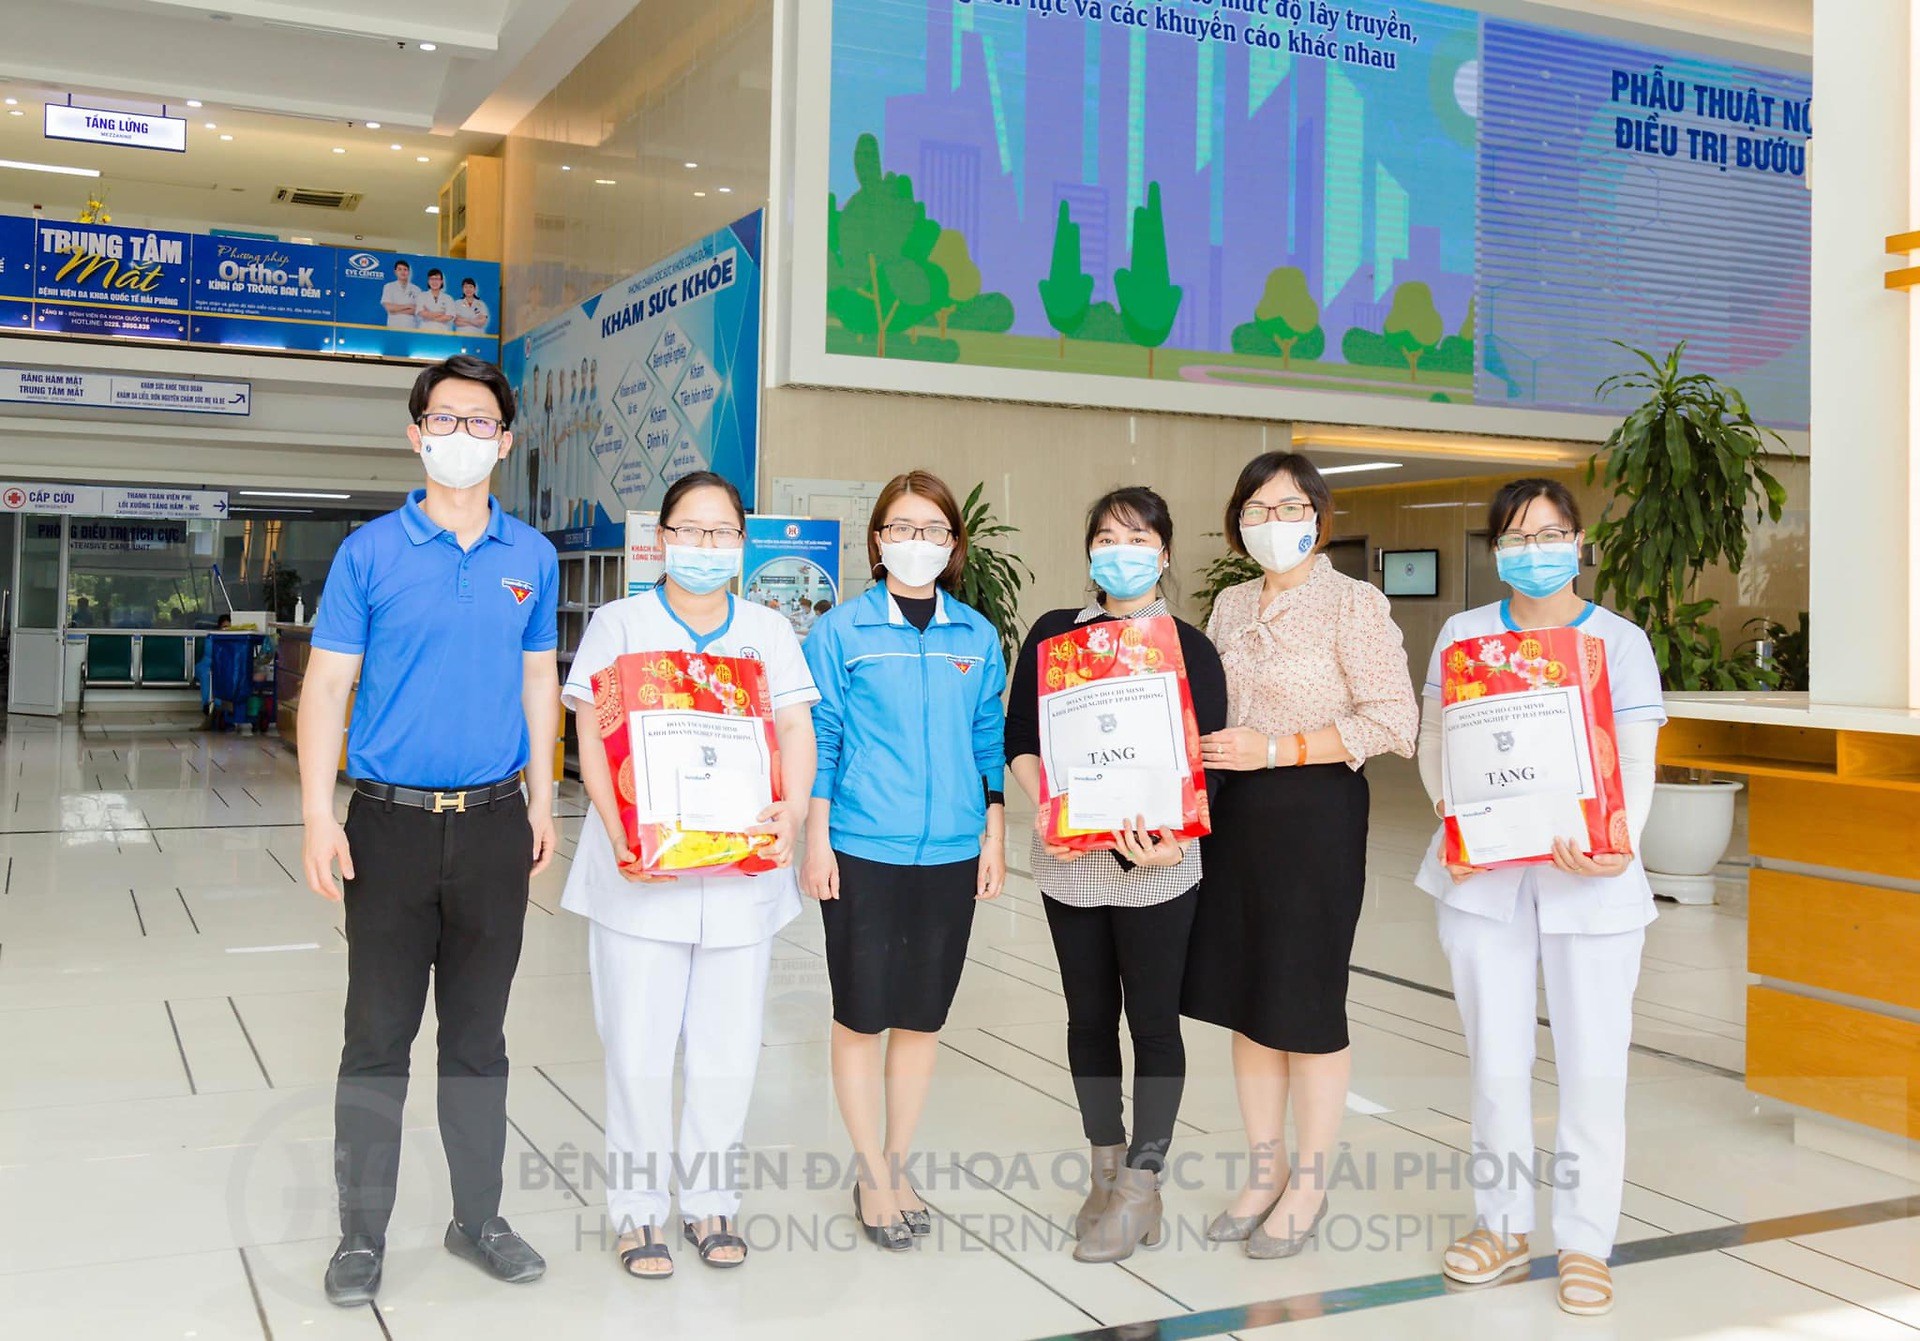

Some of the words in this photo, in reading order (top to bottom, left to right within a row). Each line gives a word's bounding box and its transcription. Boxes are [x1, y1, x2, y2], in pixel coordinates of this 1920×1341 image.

[1275, 0, 1302, 26] độ
[1309, 1, 1339, 31] lây
[1346, 10, 1418, 44] truyền,
[1110, 1, 1148, 27] các
[1155, 7, 1236, 41] khuyến
[1244, 24, 1281, 49] cáo
[1288, 30, 1337, 59] khác
[1345, 42, 1395, 69] nhau
[1611, 64, 1685, 112] PHẪU
[1693, 84, 1775, 132] THUẬT
[120, 117, 148, 134] LỬNG
[1615, 112, 1678, 156] ĐIỀU
[1686, 128, 1727, 171] TRỊ
[1736, 136, 1804, 175] BƯỚU
[41, 228, 122, 259] TRUNG
[130, 234, 182, 264] TÂM
[56, 246, 164, 292] Mắt
[219, 261, 314, 288] Ortho-K
[358, 270, 384, 279] CENTER
[60, 288, 76, 298] VIỆN
[90, 292, 108, 300] KHOA
[110, 292, 129, 301] QUỐC
[131, 294, 139, 303] TẾ
[209, 280, 230, 291] KÍNH
[232, 281, 244, 292] ÁP
[247, 283, 278, 295] TRÒNG
[280, 286, 298, 297] BAN
[602, 303, 644, 338] KHÁM
[648, 286, 677, 317] SỨC
[682, 257, 733, 302] KHỎE
[19, 385, 45, 394] TRUNG
[48, 387, 64, 396] TÂM
[29, 489, 50, 502] CẤP
[54, 491, 75, 504] CỨU
[110, 526, 127, 541] TRỊ
[130, 524, 154, 541] TÍCH
[1088, 747, 1136, 766] TẶNG
[1485, 767, 1535, 787] TẶNG
